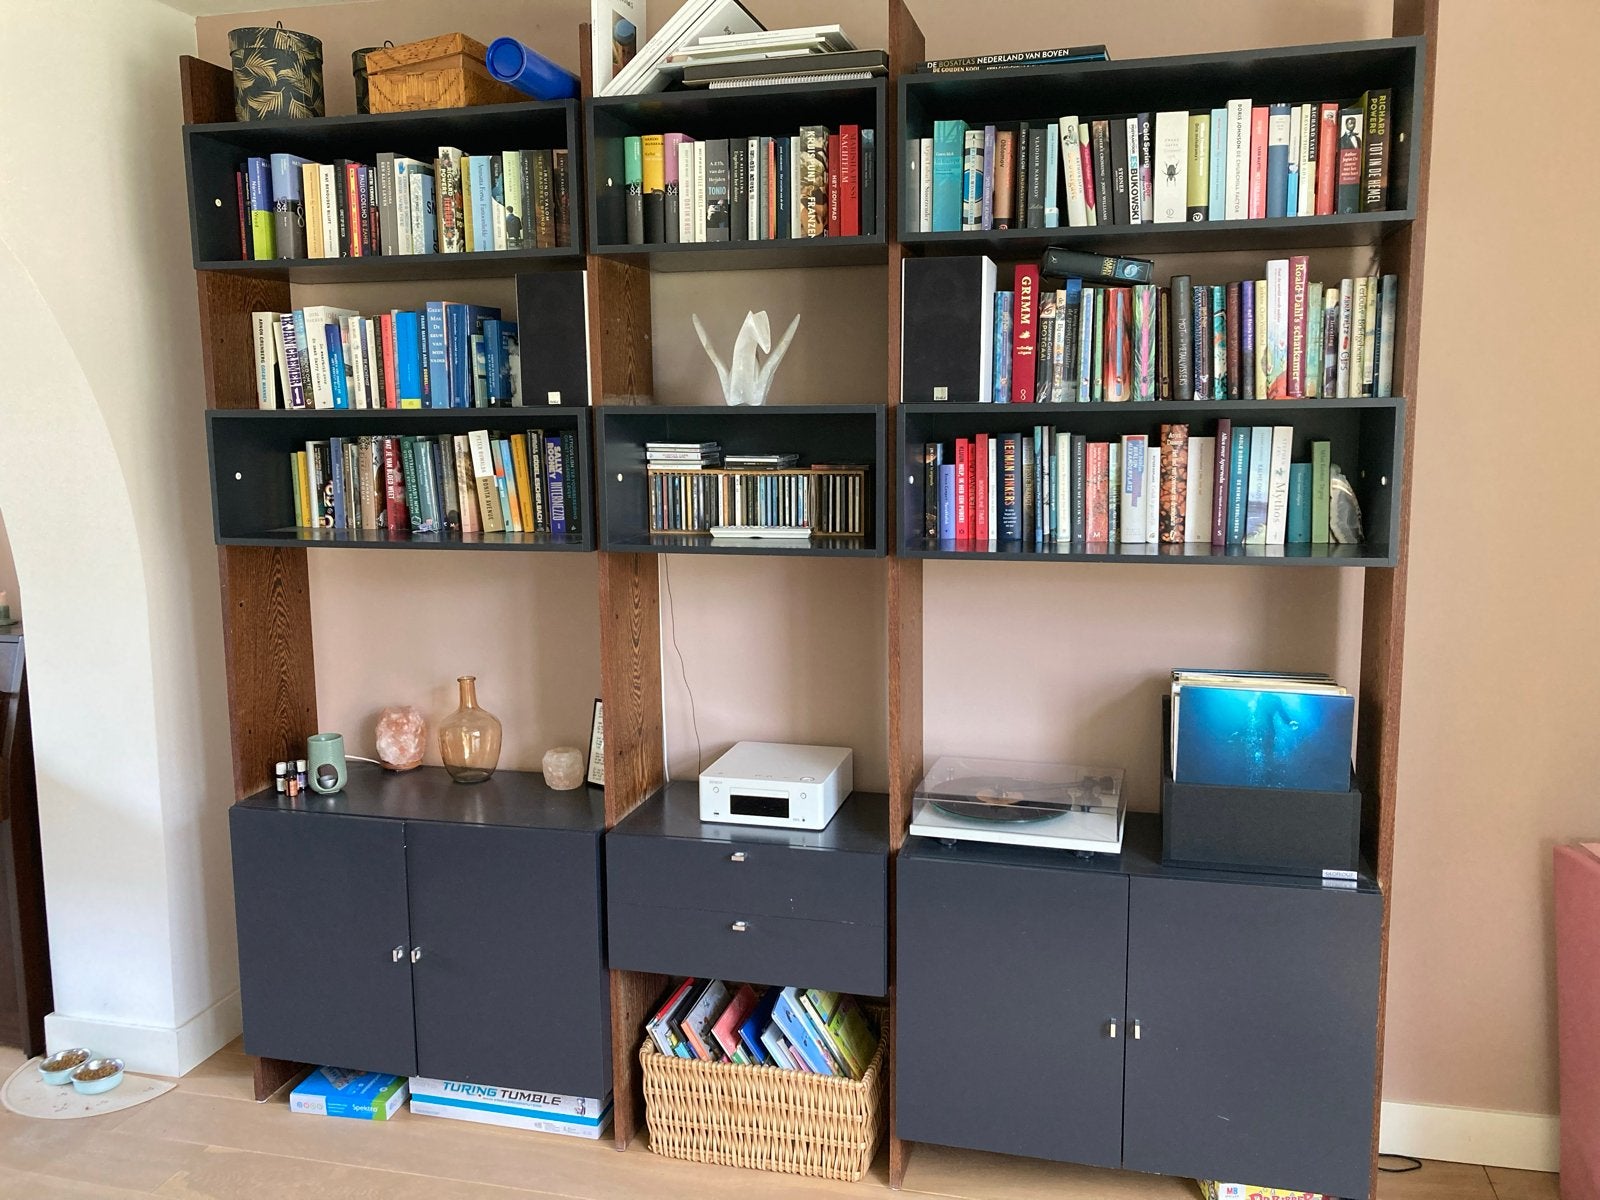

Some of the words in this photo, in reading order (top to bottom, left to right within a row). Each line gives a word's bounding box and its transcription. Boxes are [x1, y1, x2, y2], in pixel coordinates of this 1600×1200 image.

[927, 61, 937, 69] DE
[938, 58, 975, 68] BOSATLAS
[977, 54, 1024, 64] NEDERLAND
[1025, 52, 1042, 60] VAN
[1042, 49, 1069, 58] BOVEN
[1369, 98, 1378, 134] POWERS
[1377, 95, 1386, 135] RICHARD
[1142, 122, 1150, 141] Cold
[807, 131, 816, 183] KRUISPUNT
[841, 133, 849, 183] NACHTFILM
[999, 139, 1007, 168] Oblomov
[1142, 141, 1150, 168] Spring
[1236, 150, 1242, 158] DE
[1369, 142, 1383, 156] TOT
[1369, 158, 1382, 166] IN
[1368, 168, 1381, 178] DE
[708, 186, 726, 195] TONIO
[1367, 179, 1381, 204] HEMEL
[807, 197, 816, 239] FRANZEN
[1295, 263, 1304, 292] Roald
[1020, 275, 1032, 325] GRIMM
[1294, 294, 1303, 323] Dahl's
[1358, 283, 1366, 314] Terlouw
[281, 316, 294, 326] IK
[1178, 318, 1187, 333] MOT
[283, 326, 296, 345] JAN
[1354, 319, 1365, 363] Briefgeheim
[285, 347, 302, 386] CREMER
[1178, 343, 1187, 386] METAALVISSERS
[1292, 325, 1303, 381] schatkamer
[386, 450, 392, 458] JE
[547, 442, 556, 479] ROONEY
[553, 446, 563, 474] SALLY
[1004, 439, 1015, 471] HERMAN
[386, 469, 394, 485] BLOED
[957, 464, 965, 477] HELP,
[1218, 457, 1226, 484] Ayurveda
[482, 479, 491, 499] BONITA
[550, 482, 565, 521] INTERMEZZO
[1004, 473, 1015, 506] FINKERS
[1273, 482, 1286, 523] Mythos
[485, 500, 494, 521] AVENUE
[442, 1081, 497, 1097] TURING
[500, 1089, 562, 1106] TUMBLE
[1226, 1187, 1238, 1195] MB
